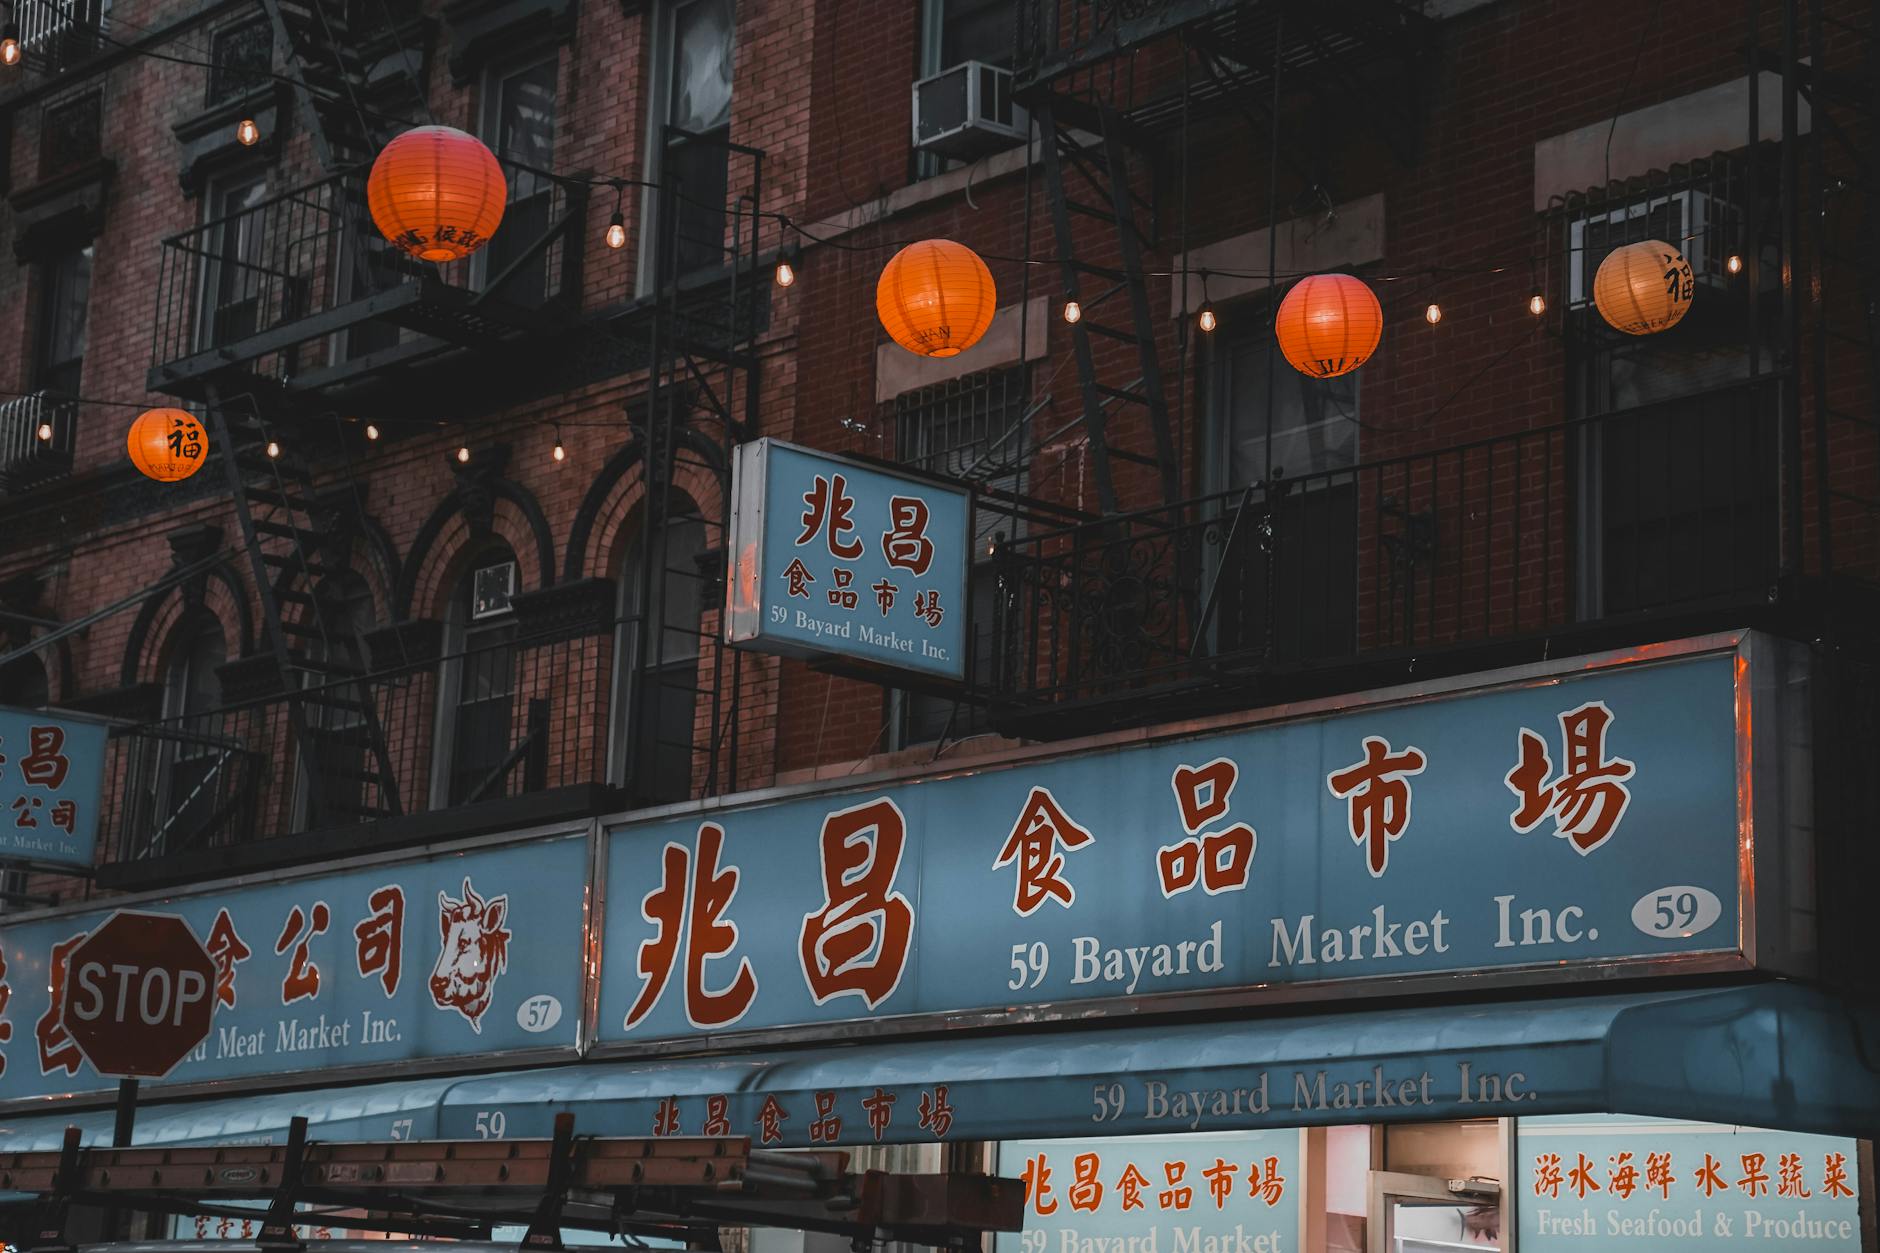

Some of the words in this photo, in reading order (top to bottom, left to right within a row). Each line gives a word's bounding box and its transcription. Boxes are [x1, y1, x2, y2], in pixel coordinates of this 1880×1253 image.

[168, 419, 202, 460] 福
[795, 473, 935, 577] 兆昌
[781, 558, 945, 629] 食品市場
[771, 605, 787, 623] 59
[796, 611, 850, 637] Bayard
[859, 625, 914, 653] Market
[922, 639, 950, 661] Inc.
[0, 725, 70, 792] 昌
[0, 794, 77, 836] 公司
[14, 835, 53, 852] Market
[624, 700, 1636, 1030] 兆昌食品市場
[1654, 894, 1698, 929] 59
[1008, 941, 1050, 990] 59
[1070, 921, 1224, 994] Bayard
[1268, 904, 1450, 968] Market
[1494, 894, 1599, 949] Inc.
[74, 961, 207, 1026] STOP
[527, 999, 551, 1027] 57
[216, 1026, 266, 1059] Meat
[276, 1015, 350, 1052] Market
[361, 1010, 402, 1043] Inc.
[653, 1085, 954, 1144] 兆昌食品市場
[1092, 1083, 1125, 1121] 59
[1144, 1074, 1269, 1131] Bayard
[1294, 1067, 1435, 1113] Market
[1458, 1062, 1538, 1105] Inc.
[390, 1119, 413, 1141] 57
[475, 1111, 506, 1139] 59
[1020, 1152, 1287, 1215] 兆昌食品市場
[1693, 1151, 1857, 1200] 水果蔬菜
[1021, 1227, 1047, 1253] 59
[1059, 1225, 1158, 1253] Bayard
[1173, 1223, 1282, 1253] Market
[1537, 1209, 1597, 1235] Fresh
[1607, 1209, 1703, 1237] Seafood
[1714, 1213, 1733, 1236] &
[1744, 1210, 1852, 1240] Produce
